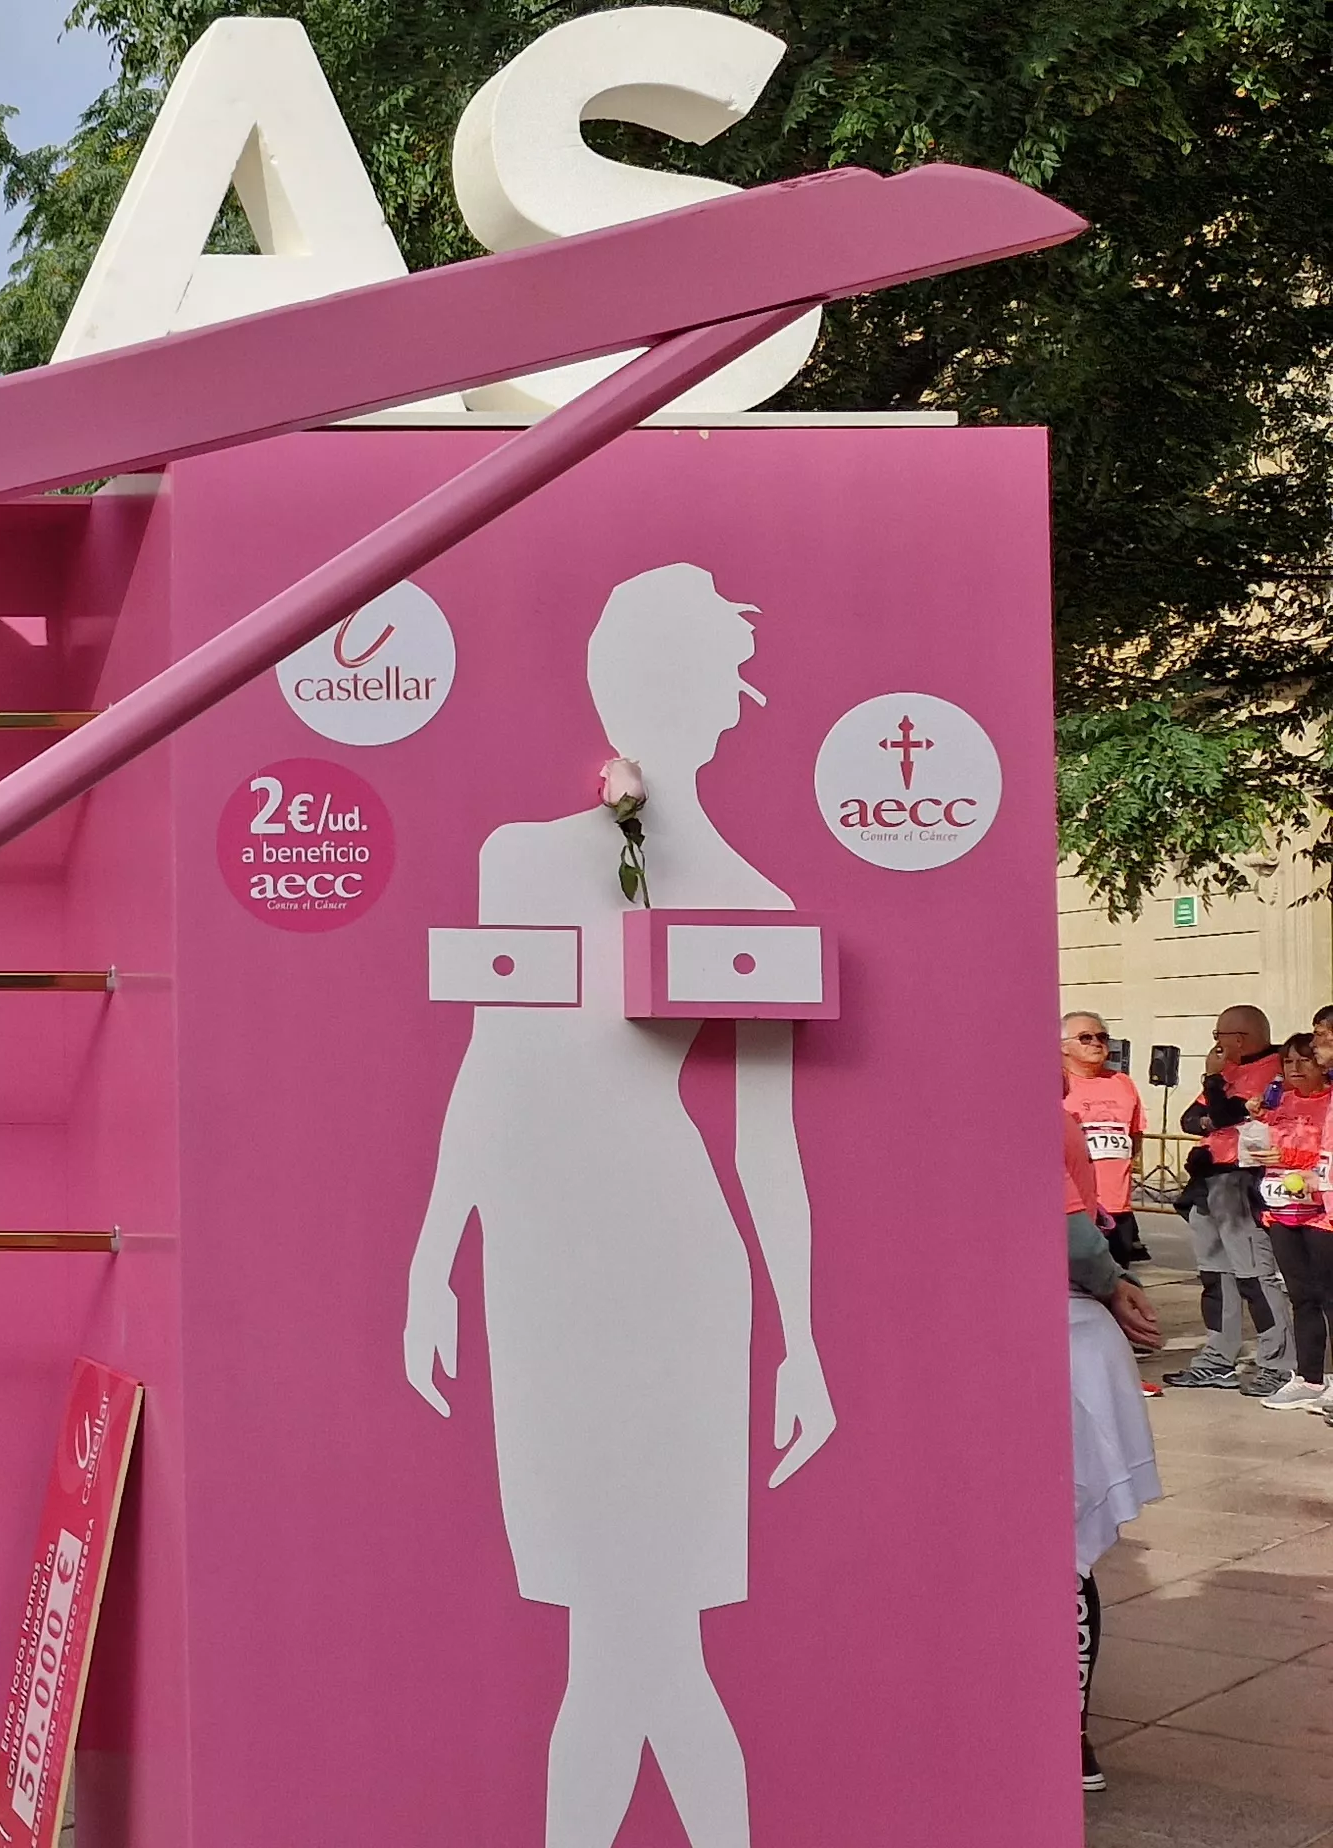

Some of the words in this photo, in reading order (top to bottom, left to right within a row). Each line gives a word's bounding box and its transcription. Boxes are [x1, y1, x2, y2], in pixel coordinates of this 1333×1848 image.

[294, 666, 437, 701] castellar
[839, 798, 977, 828] aecc
[242, 847, 254, 863] a
[263, 841, 369, 863] beneficio
[860, 830, 898, 842] Contra
[904, 831, 912, 842] el
[250, 873, 362, 899] aecc
[302, 900, 310, 910] el
[1087, 1135, 1129, 1149] 1792
[82, 1391, 109, 1505] castellar
[75, 1518, 95, 1595] HUESCA
[0, 1701, 16, 1752] Entre
[11, 1637, 27, 1694] todos
[22, 1562, 41, 1632] hemos
[6, 1662, 33, 1789] conseguido
[29, 1576, 49, 1657] superar
[43, 1543, 55, 1573] los
[19, 1609, 63, 1803] 50.000
[57, 1551, 75, 1585] €
